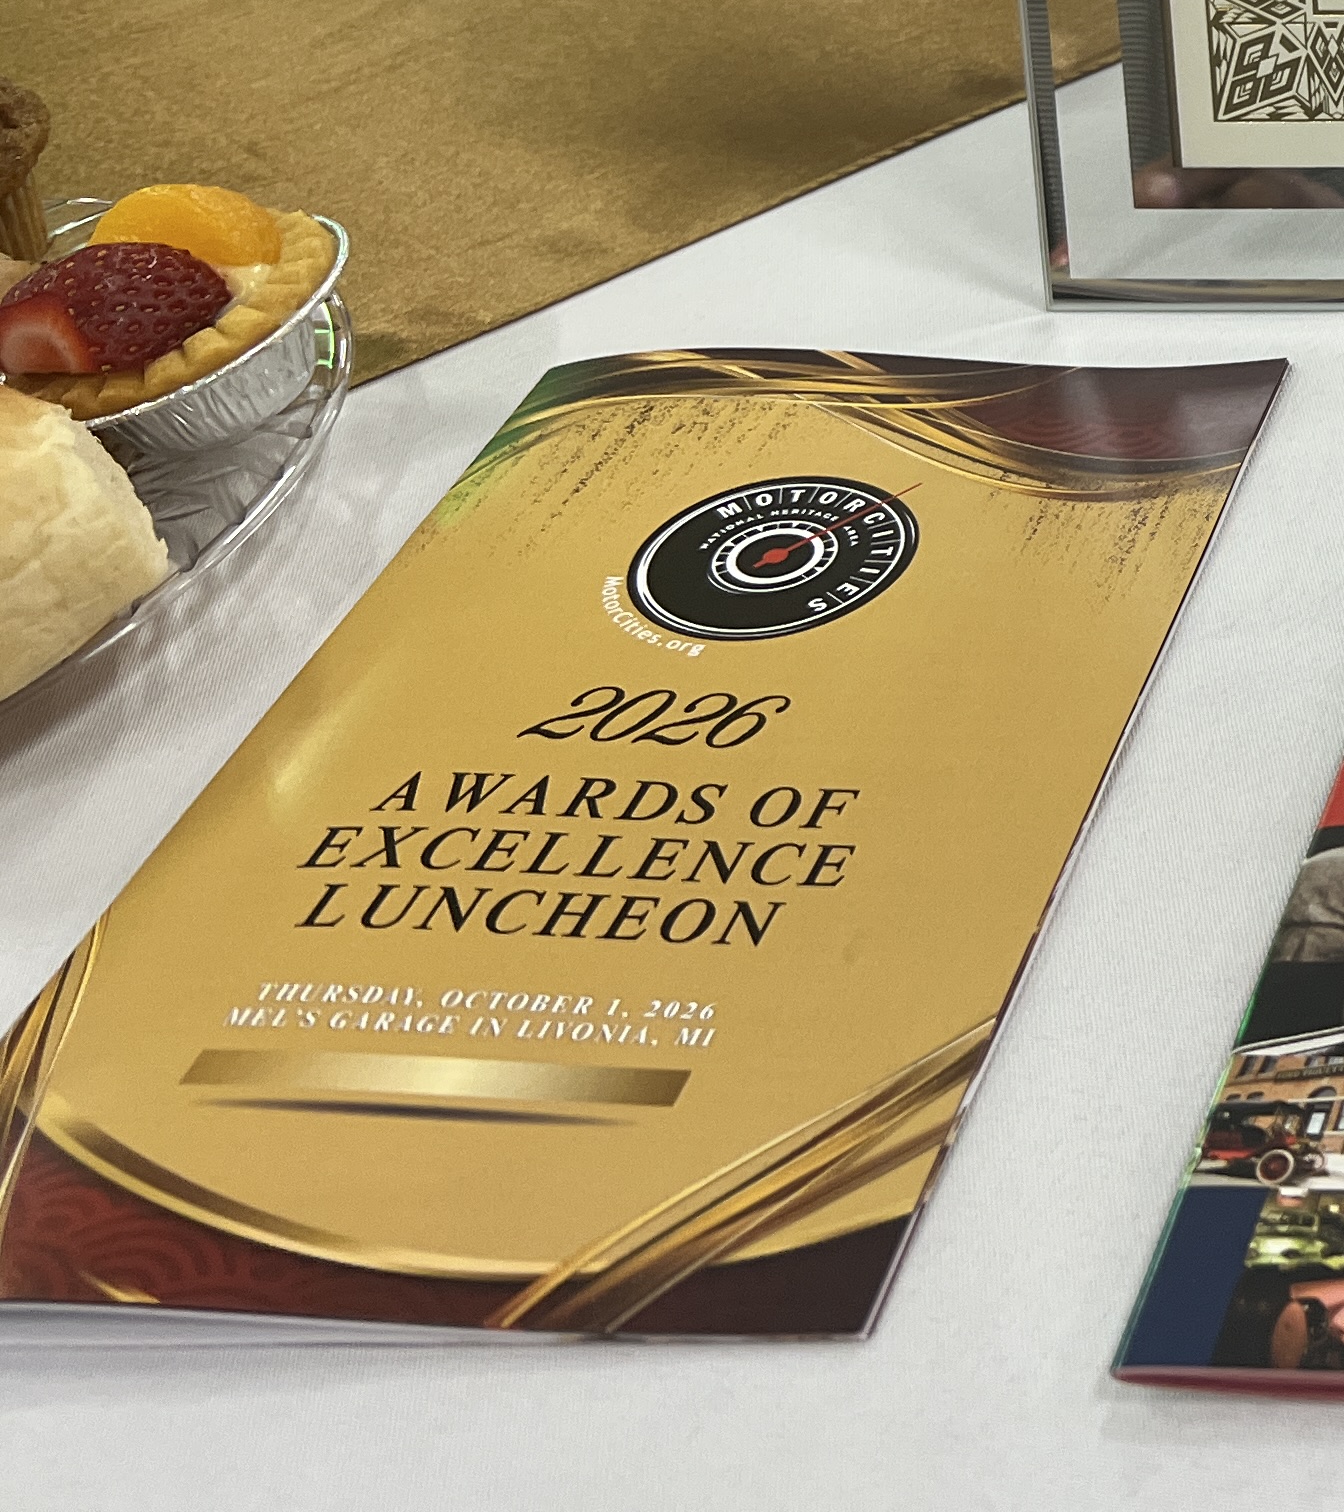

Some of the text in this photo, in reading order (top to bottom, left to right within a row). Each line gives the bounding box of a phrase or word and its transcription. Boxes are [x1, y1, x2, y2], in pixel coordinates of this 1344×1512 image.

[699, 508, 858, 551] NATIONAL HERITAGE AREA
[717, 489, 893, 613] MOTORCITIES
[602, 575, 707, 658] MotorCities.org
[517, 685, 792, 749] 2026
[369, 771, 859, 831] AWARDS OF
[296, 826, 856, 889] EXCELLENCE
[294, 882, 788, 949] LUNCHEON
[329, 1009, 460, 1036] GARAGE
[469, 1016, 503, 1038] IN
[673, 1026, 717, 1048] MI
[440, 988, 593, 1016] OCTOBER
[644, 999, 717, 1021] 2026
